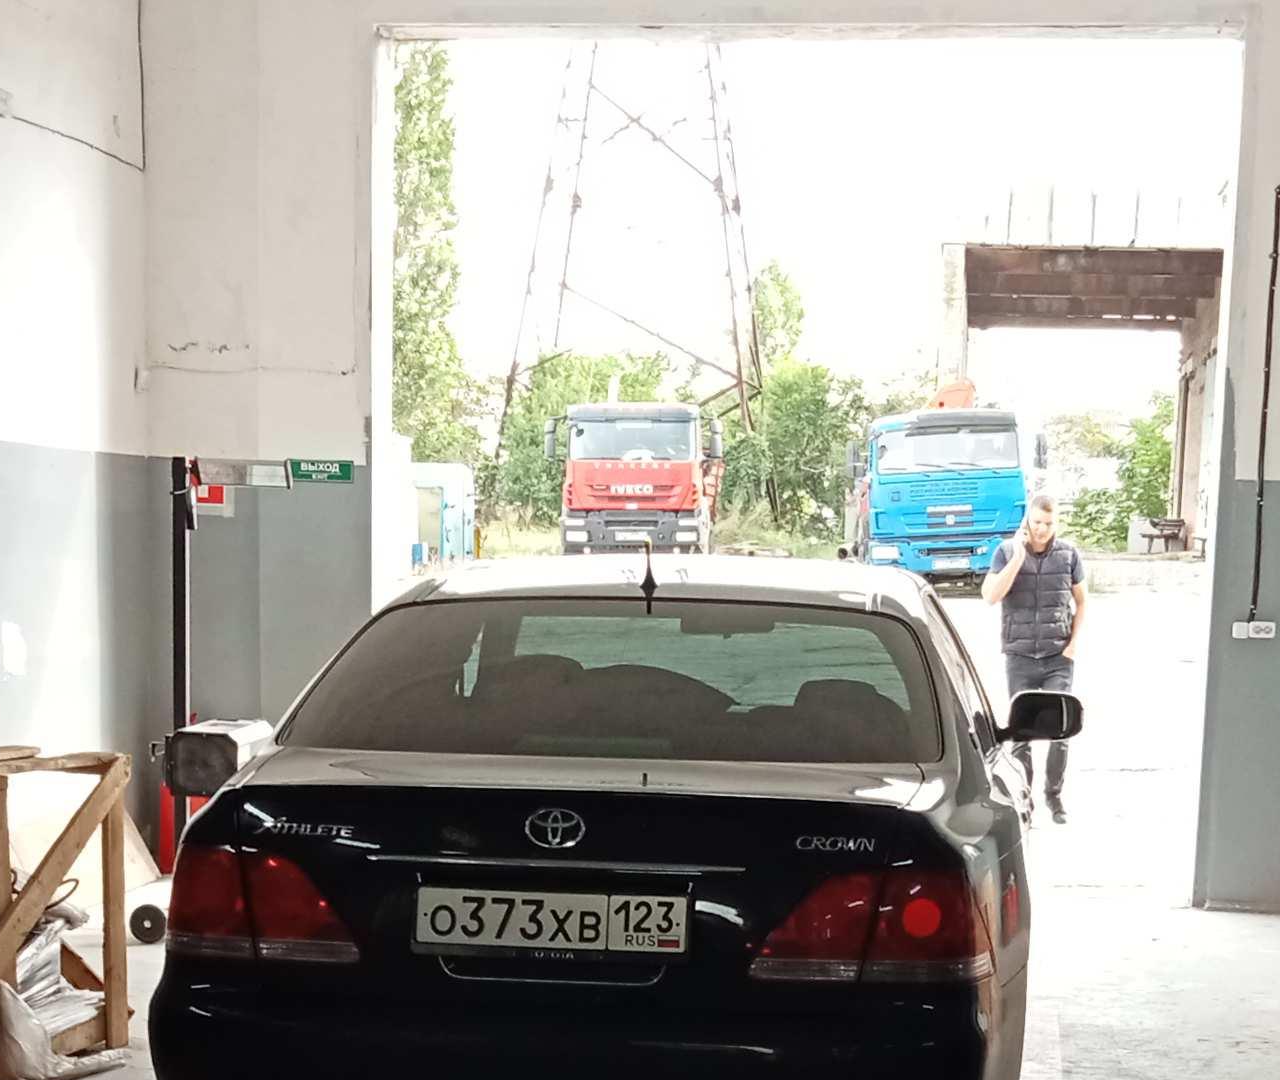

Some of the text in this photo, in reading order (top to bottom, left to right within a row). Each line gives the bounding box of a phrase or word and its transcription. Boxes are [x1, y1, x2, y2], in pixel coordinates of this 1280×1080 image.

[300, 462, 340, 473] ВЫХОД
[255, 817, 355, 837] ATHLETE
[796, 836, 876, 851] CROWN
[614, 901, 675, 934] 123
[624, 934, 656, 947] RUS
